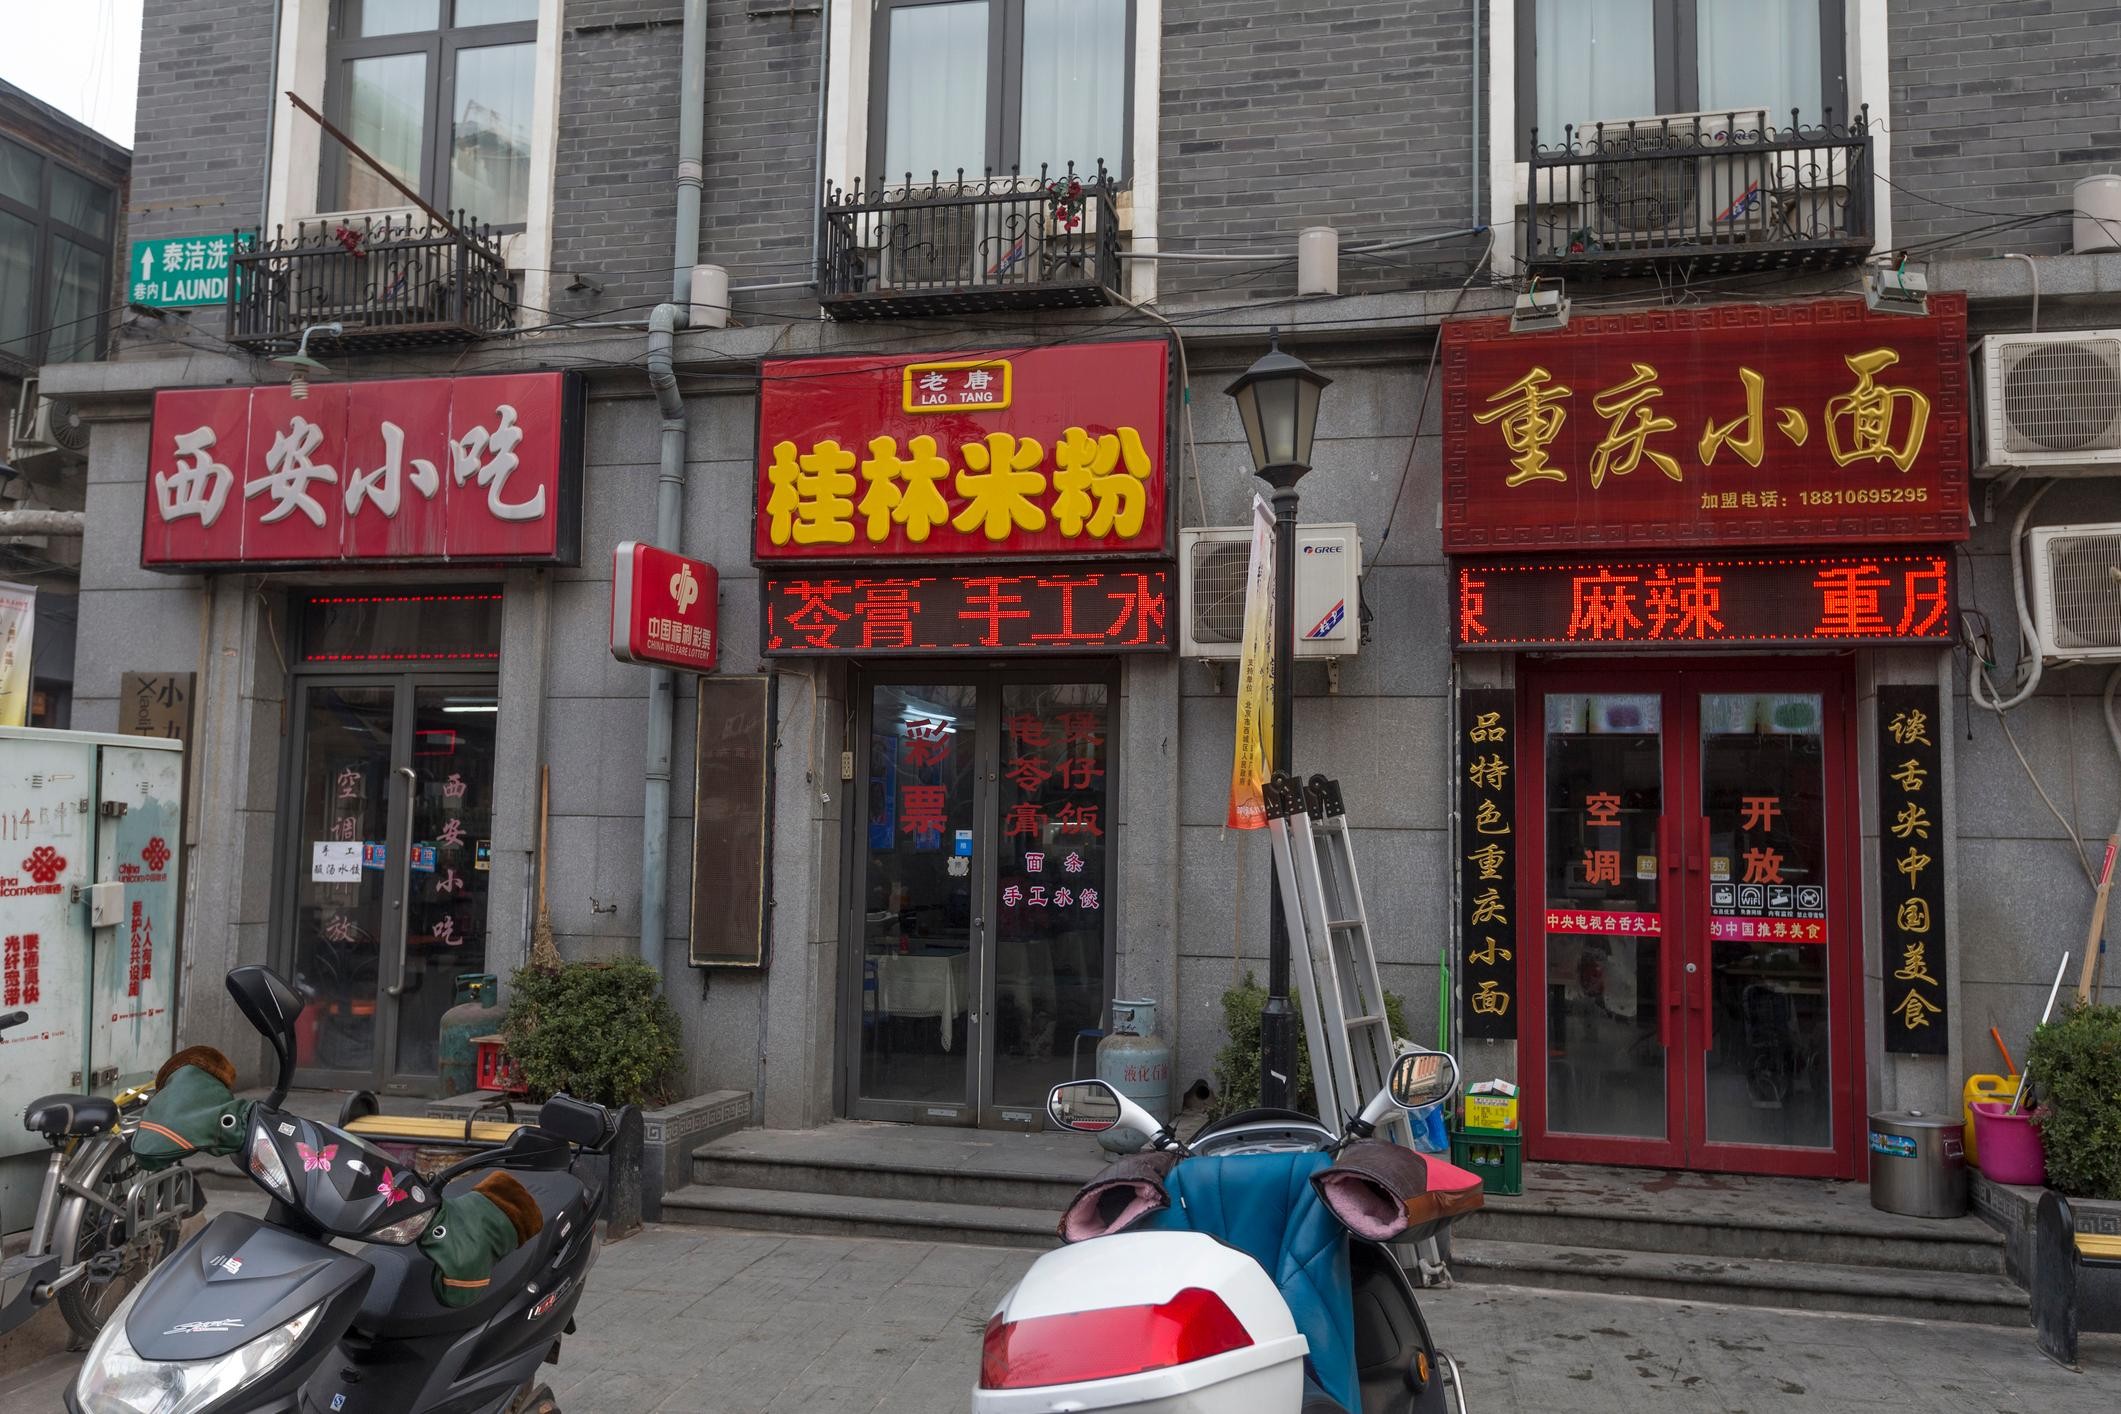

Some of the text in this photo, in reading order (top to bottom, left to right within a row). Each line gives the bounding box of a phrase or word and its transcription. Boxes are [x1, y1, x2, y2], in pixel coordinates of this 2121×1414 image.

[133, 282, 158, 300] 巷内
[919, 369, 994, 392] 老唐
[921, 392, 993, 405] LAO TANG
[1472, 346, 1931, 490] 重庆小面
[155, 403, 546, 529] 西安小吃
[766, 426, 1151, 547] 桂林米粉
[1314, 546, 1343, 554] GREE
[1567, 566, 1724, 638] 麻辣
[646, 639, 710, 660] CHINA WELFARE LOTTERY
[648, 617, 712, 651] 中国福利彩票
[900, 718, 953, 835] 彩票
[431, 773, 467, 947] 西安小吃
[1025, 852, 1085, 873] 面条
[1467, 711, 1513, 1016] 品特色重庆小面
[1582, 793, 1621, 887] 空调
[1741, 796, 1784, 884] 开放
[1888, 708, 1943, 1031] 谈舌尖中国美食
[1002, 885, 1100, 910] 手工水饺
[1547, 913, 1661, 932] 中央电视台舌尖上
[1742, 897, 1760, 906] WiFi
[1710, 921, 1821, 939] 的中国推荐美食
[4, 935, 20, 1007] 光纤宽带
